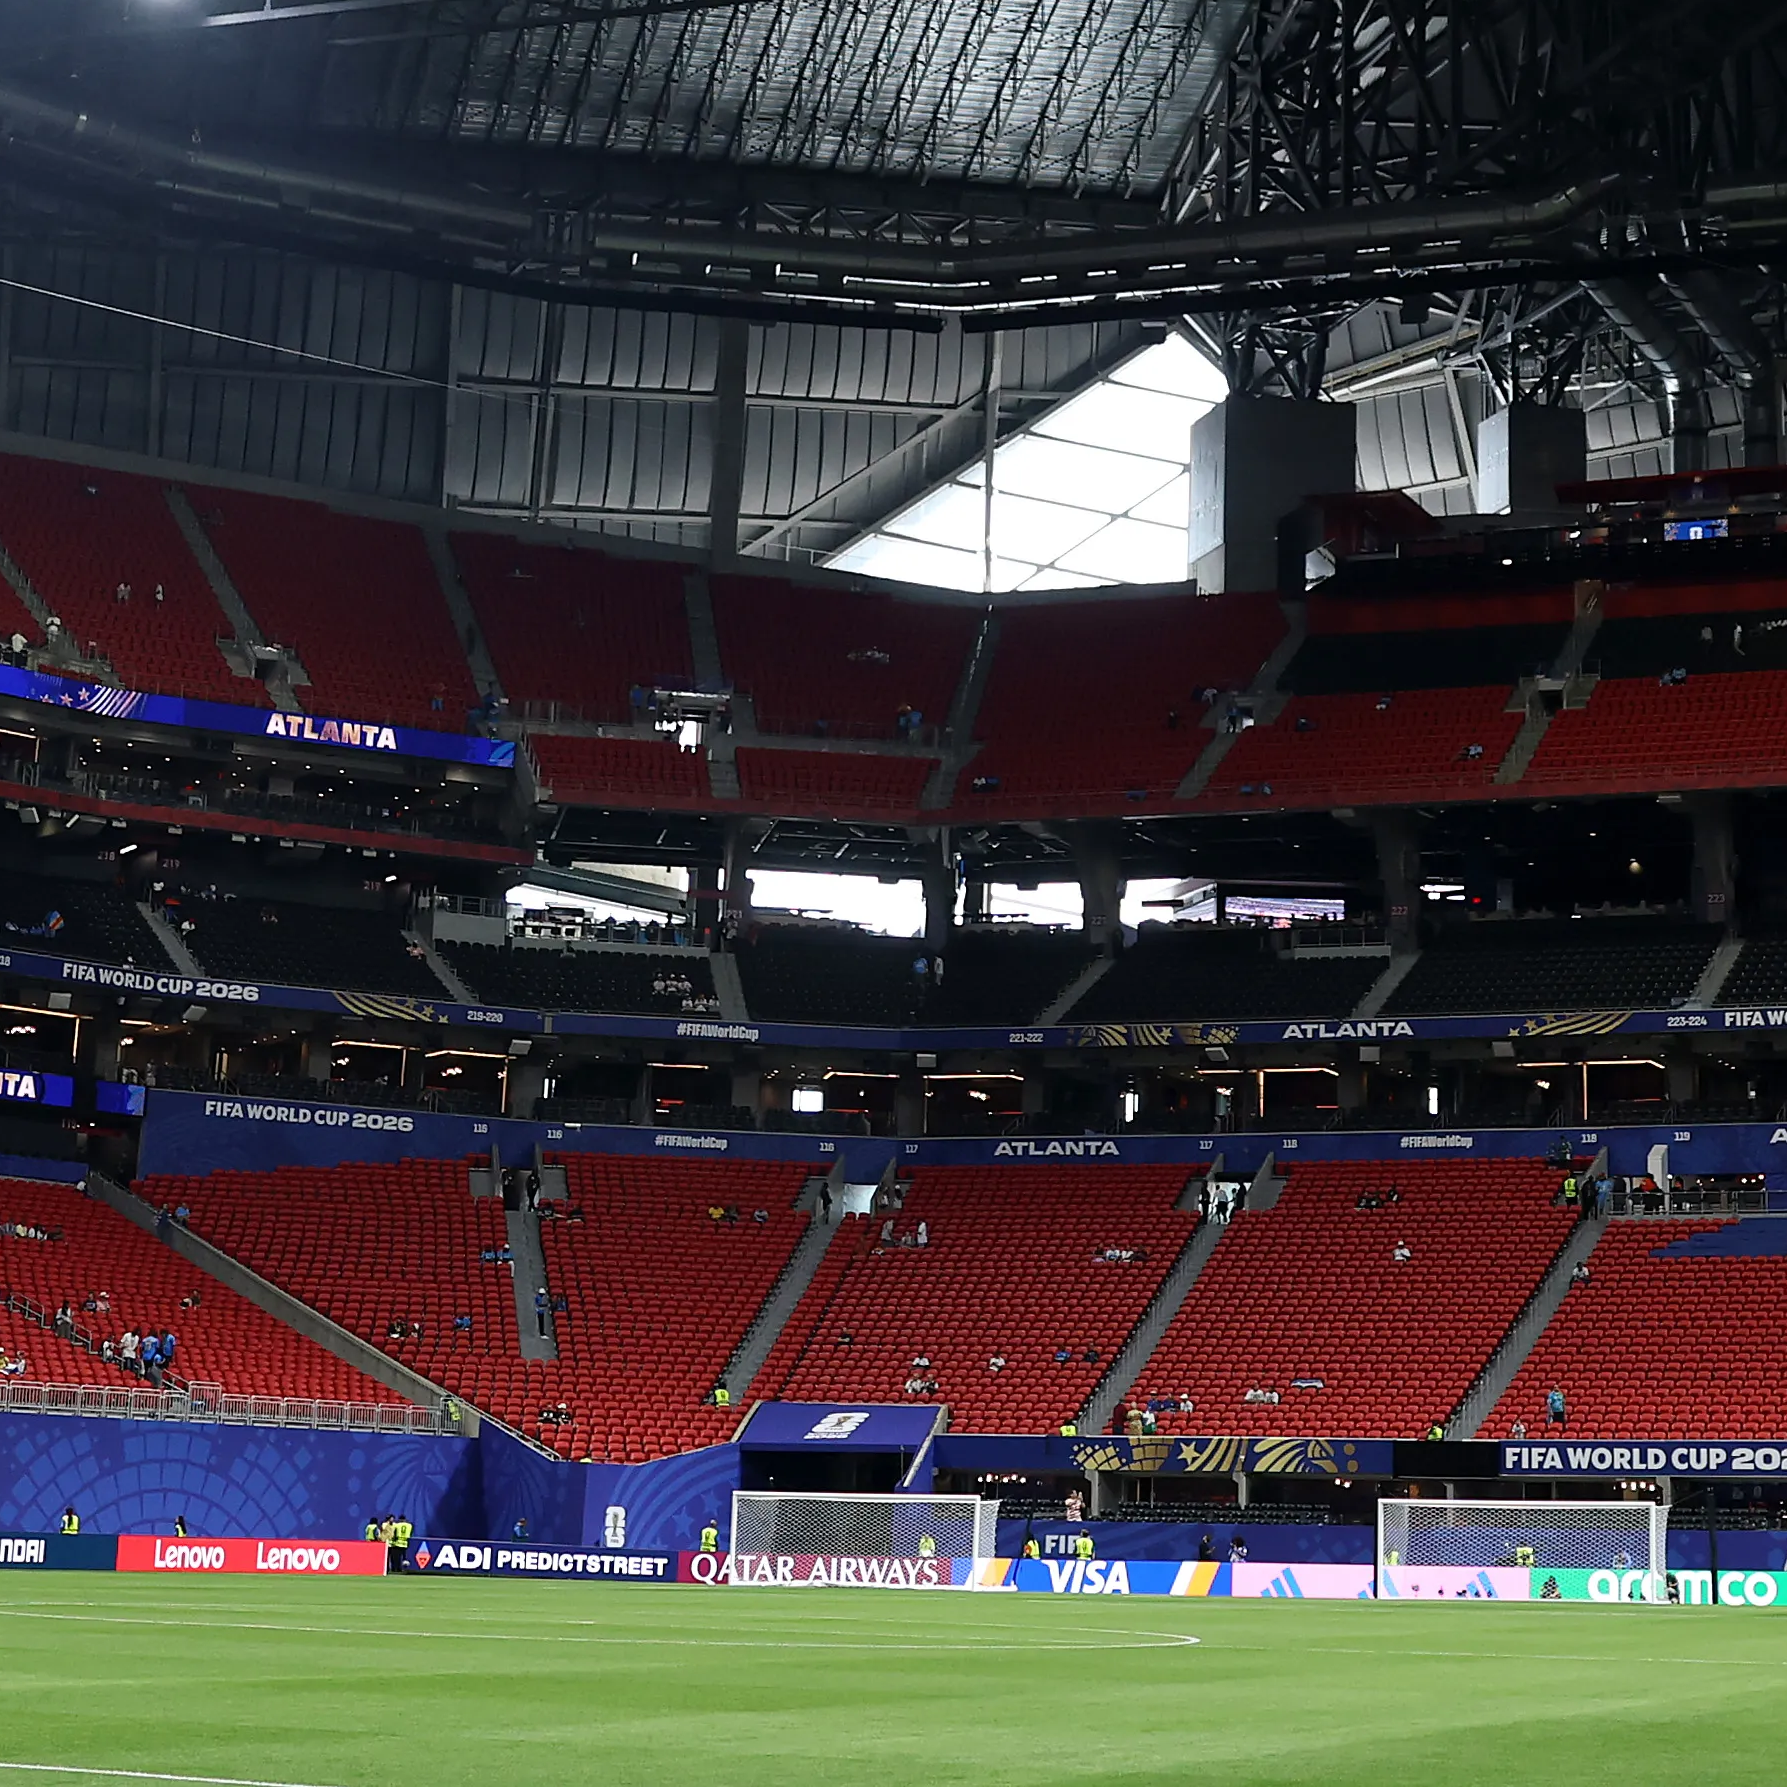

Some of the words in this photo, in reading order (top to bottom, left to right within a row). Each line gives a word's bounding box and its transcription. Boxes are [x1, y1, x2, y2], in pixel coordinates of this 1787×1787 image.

[266, 713, 396, 749] ATLANTA
[1707, 893, 1725, 904] 223
[63, 960, 96, 981] FIFA
[99, 965, 155, 990] WORLD
[157, 974, 194, 994] CUP
[196, 979, 261, 1001] 2026
[467, 1008, 505, 1022] 219-220
[1667, 1016, 1707, 1026] 223-224
[1723, 1009, 1764, 1026] FIFA
[677, 1020, 761, 1042] #FIFAWorldCup
[1281, 1019, 1414, 1038] ATLANTA
[206, 1101, 243, 1117] FIFA
[247, 1101, 313, 1122] WORLD
[314, 1110, 349, 1126] CUP
[352, 1113, 413, 1131] 2026
[655, 1135, 727, 1150] #FIFAWorldCup
[994, 1141, 1119, 1155] ATLANTA
[1401, 1135, 1472, 1148] #FIFAWorldCup
[1506, 1448, 1563, 1469] FIFA
[1567, 1448, 1666, 1469] WORLD
[1672, 1448, 1726, 1469] CUP
[155, 1539, 224, 1568] Lenovo
[1044, 1533, 1082, 1555] FIF
[257, 1542, 340, 1570] Lenovo
[434, 1545, 491, 1569] ADI
[498, 1551, 668, 1575] PREDICTSTREET
[689, 1552, 796, 1585] QATAR
[808, 1555, 940, 1586] AIRWAYS
[1041, 1558, 1132, 1595] VISA
[1587, 1568, 1779, 1606] aramco
